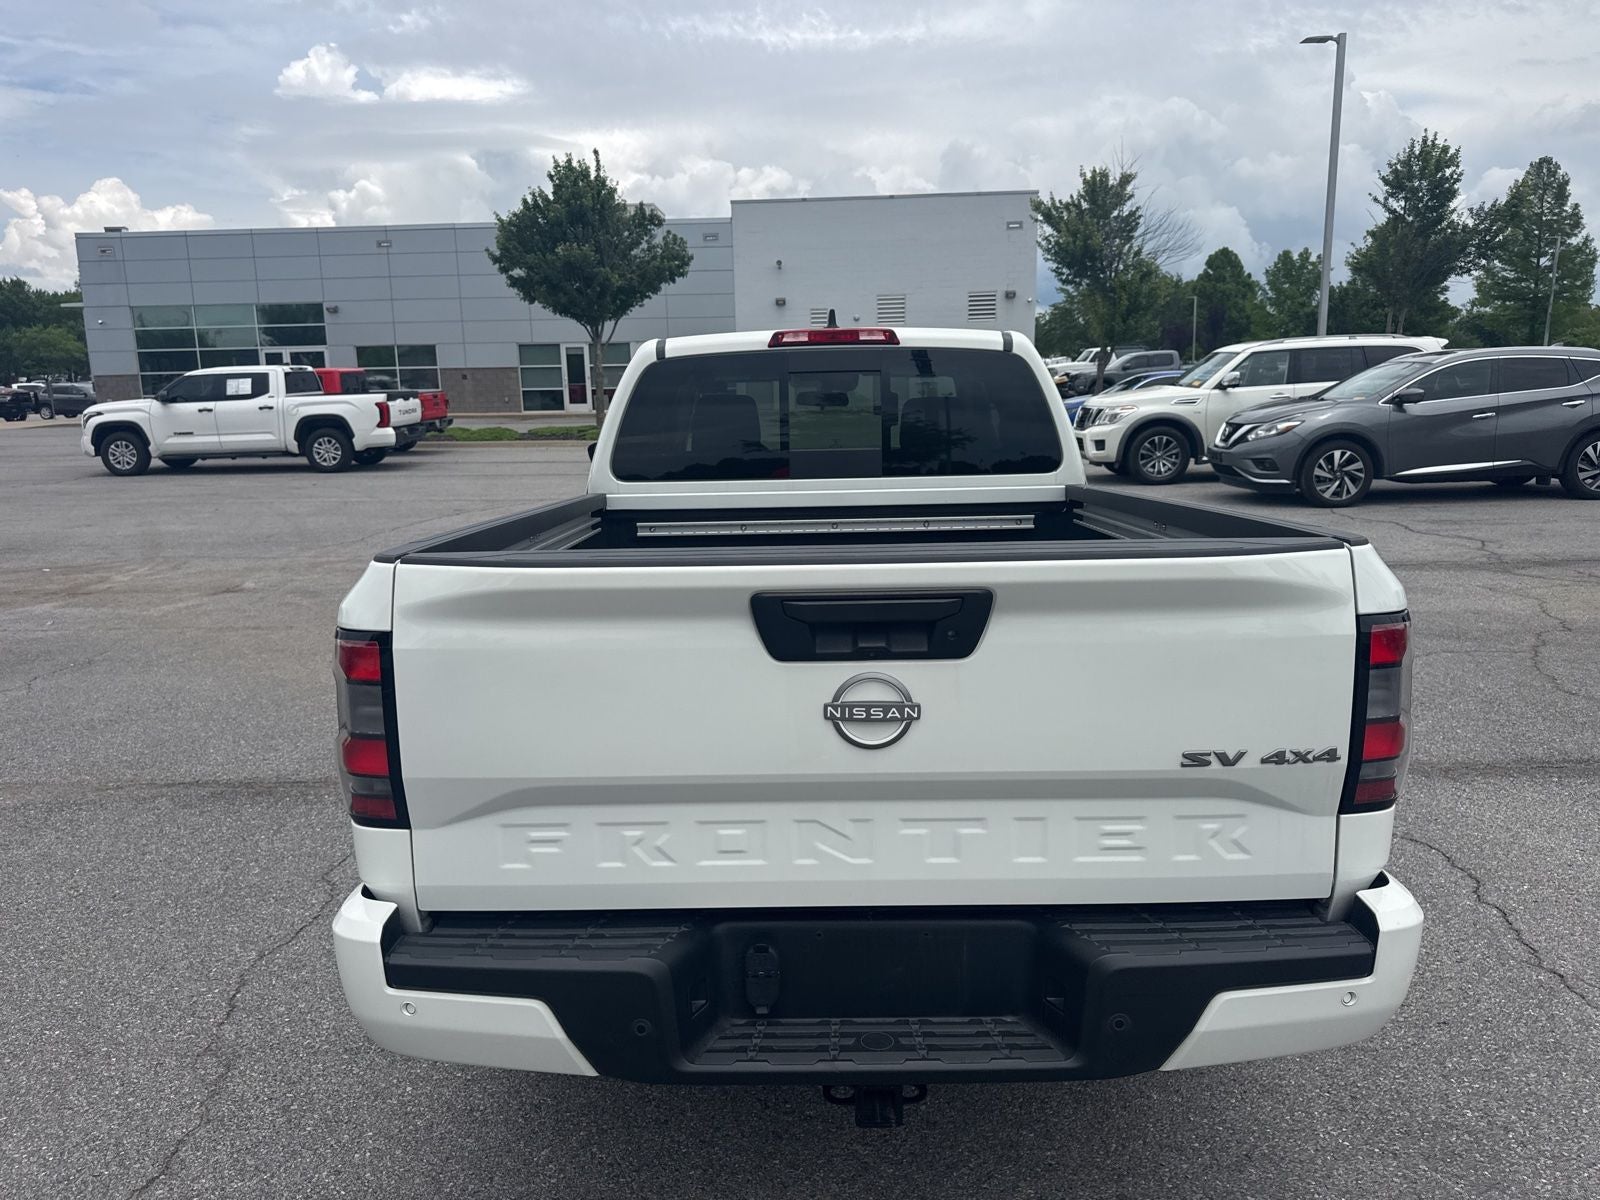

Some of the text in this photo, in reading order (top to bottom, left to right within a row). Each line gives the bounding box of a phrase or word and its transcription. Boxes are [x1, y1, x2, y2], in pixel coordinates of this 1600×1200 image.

[827, 706, 918, 719] NISSAN
[1180, 749, 1248, 768] SV
[498, 812, 1252, 869] FRONTIER
